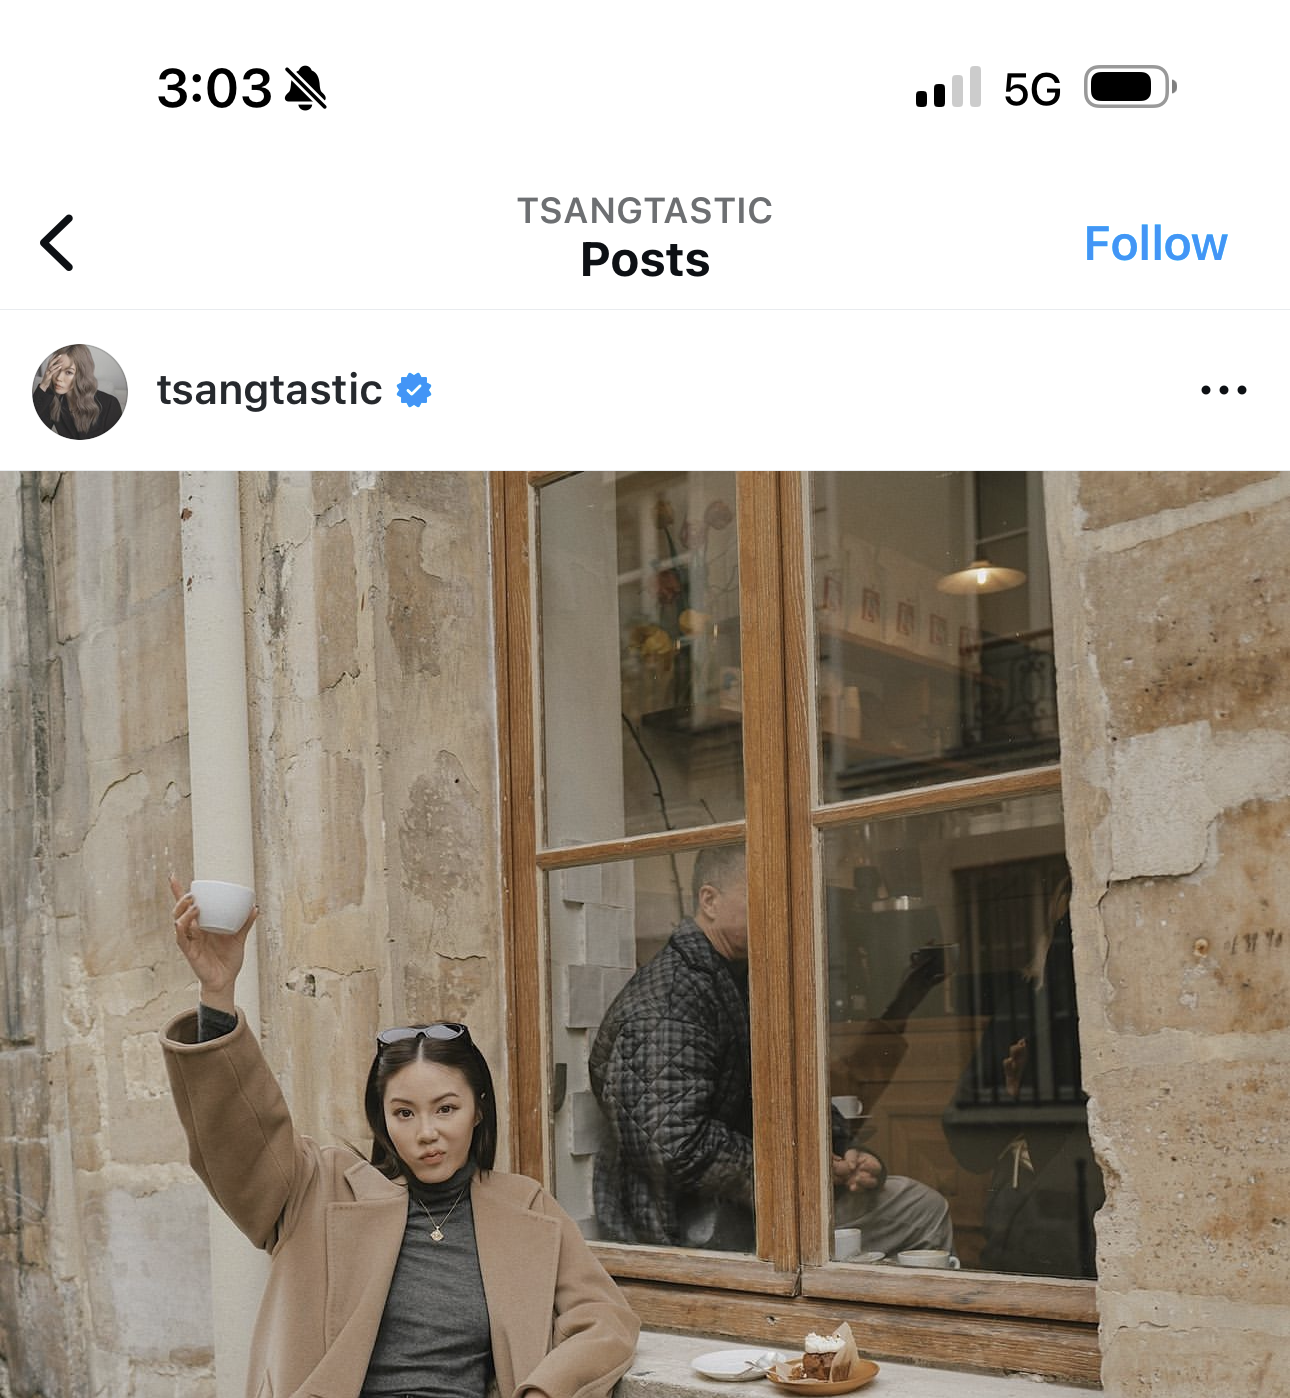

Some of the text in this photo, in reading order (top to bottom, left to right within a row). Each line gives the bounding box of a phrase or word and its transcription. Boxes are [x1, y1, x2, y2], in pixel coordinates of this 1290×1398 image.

[157, 67, 272, 109] 3:03
[1004, 71, 1061, 107] 5G
[517, 196, 772, 225] TSANGTASTIC
[582, 241, 710, 278] Posts
[1086, 223, 1229, 262] Follow
[156, 371, 383, 413] tsangtastic
